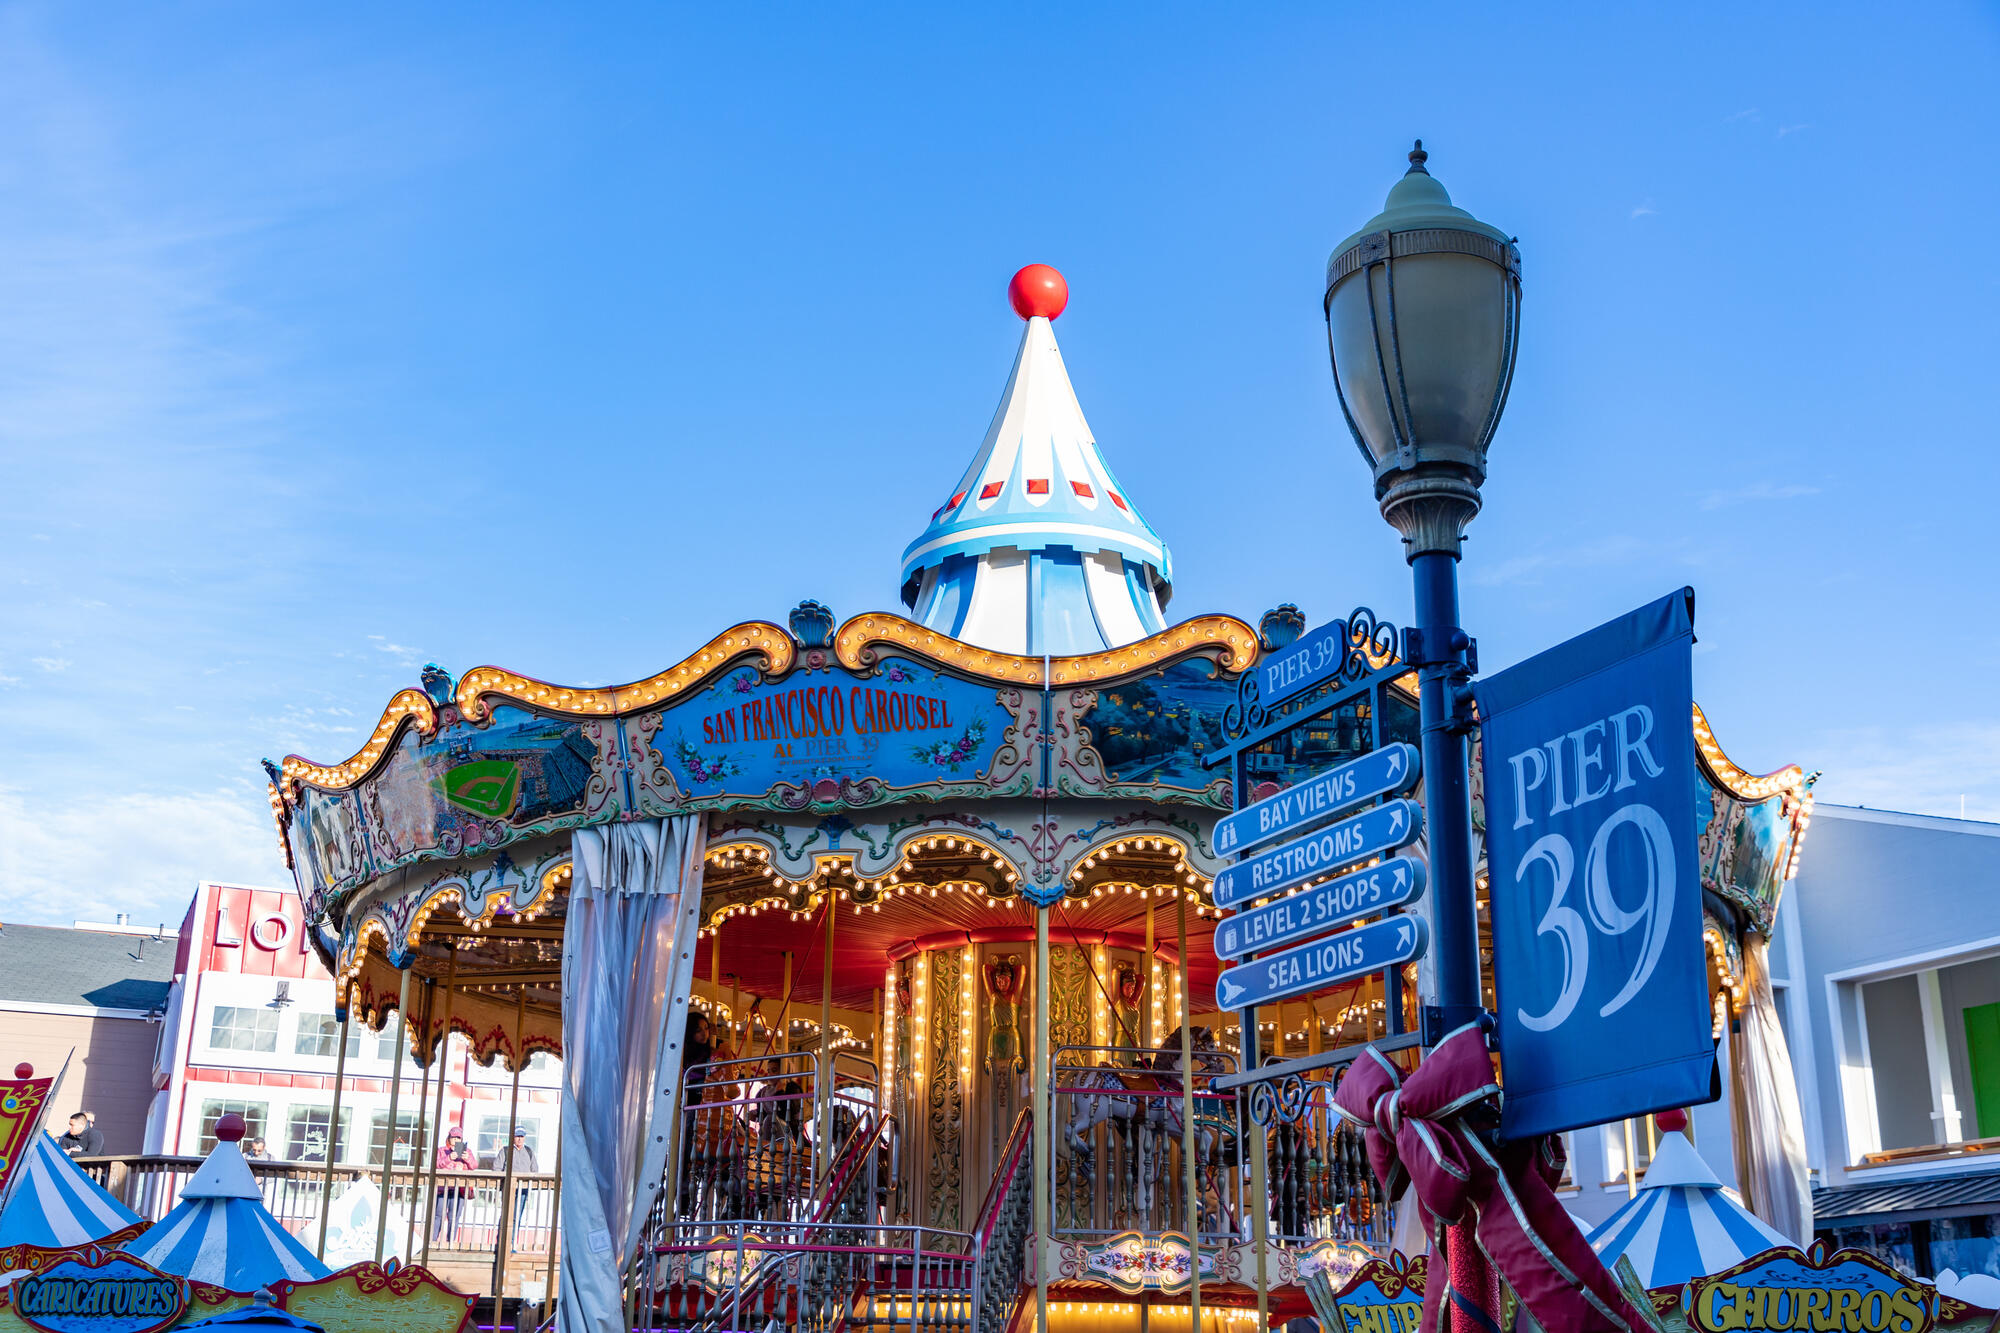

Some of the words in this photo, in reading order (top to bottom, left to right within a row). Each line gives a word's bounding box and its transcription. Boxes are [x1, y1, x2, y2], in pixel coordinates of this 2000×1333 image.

[1266, 650, 1316, 695] PIER
[1315, 635, 1335, 673] 39
[703, 706, 737, 745] SAN
[741, 686, 844, 743] FRANCISCO
[849, 686, 953, 736] CAROUSEL
[773, 743, 793, 758] At
[805, 738, 850, 756] PIER
[857, 735, 880, 753] 39
[1508, 704, 1664, 830] PIER
[1260, 797, 1298, 833] BAY
[1298, 774, 1357, 816] VIEWS
[1252, 823, 1364, 889] RESTROOMS
[214, 907, 311, 954] LO
[1244, 905, 1296, 945] LEVEL
[1301, 899, 1311, 923] 2
[1316, 874, 1381, 921] SHOPS
[1515, 804, 1676, 1032] 39
[1268, 955, 1302, 990] SEA
[1305, 936, 1364, 978] LIONS
[22, 1278, 177, 1316] CARICATURES
[1699, 1282, 1925, 1333] CHURROS
